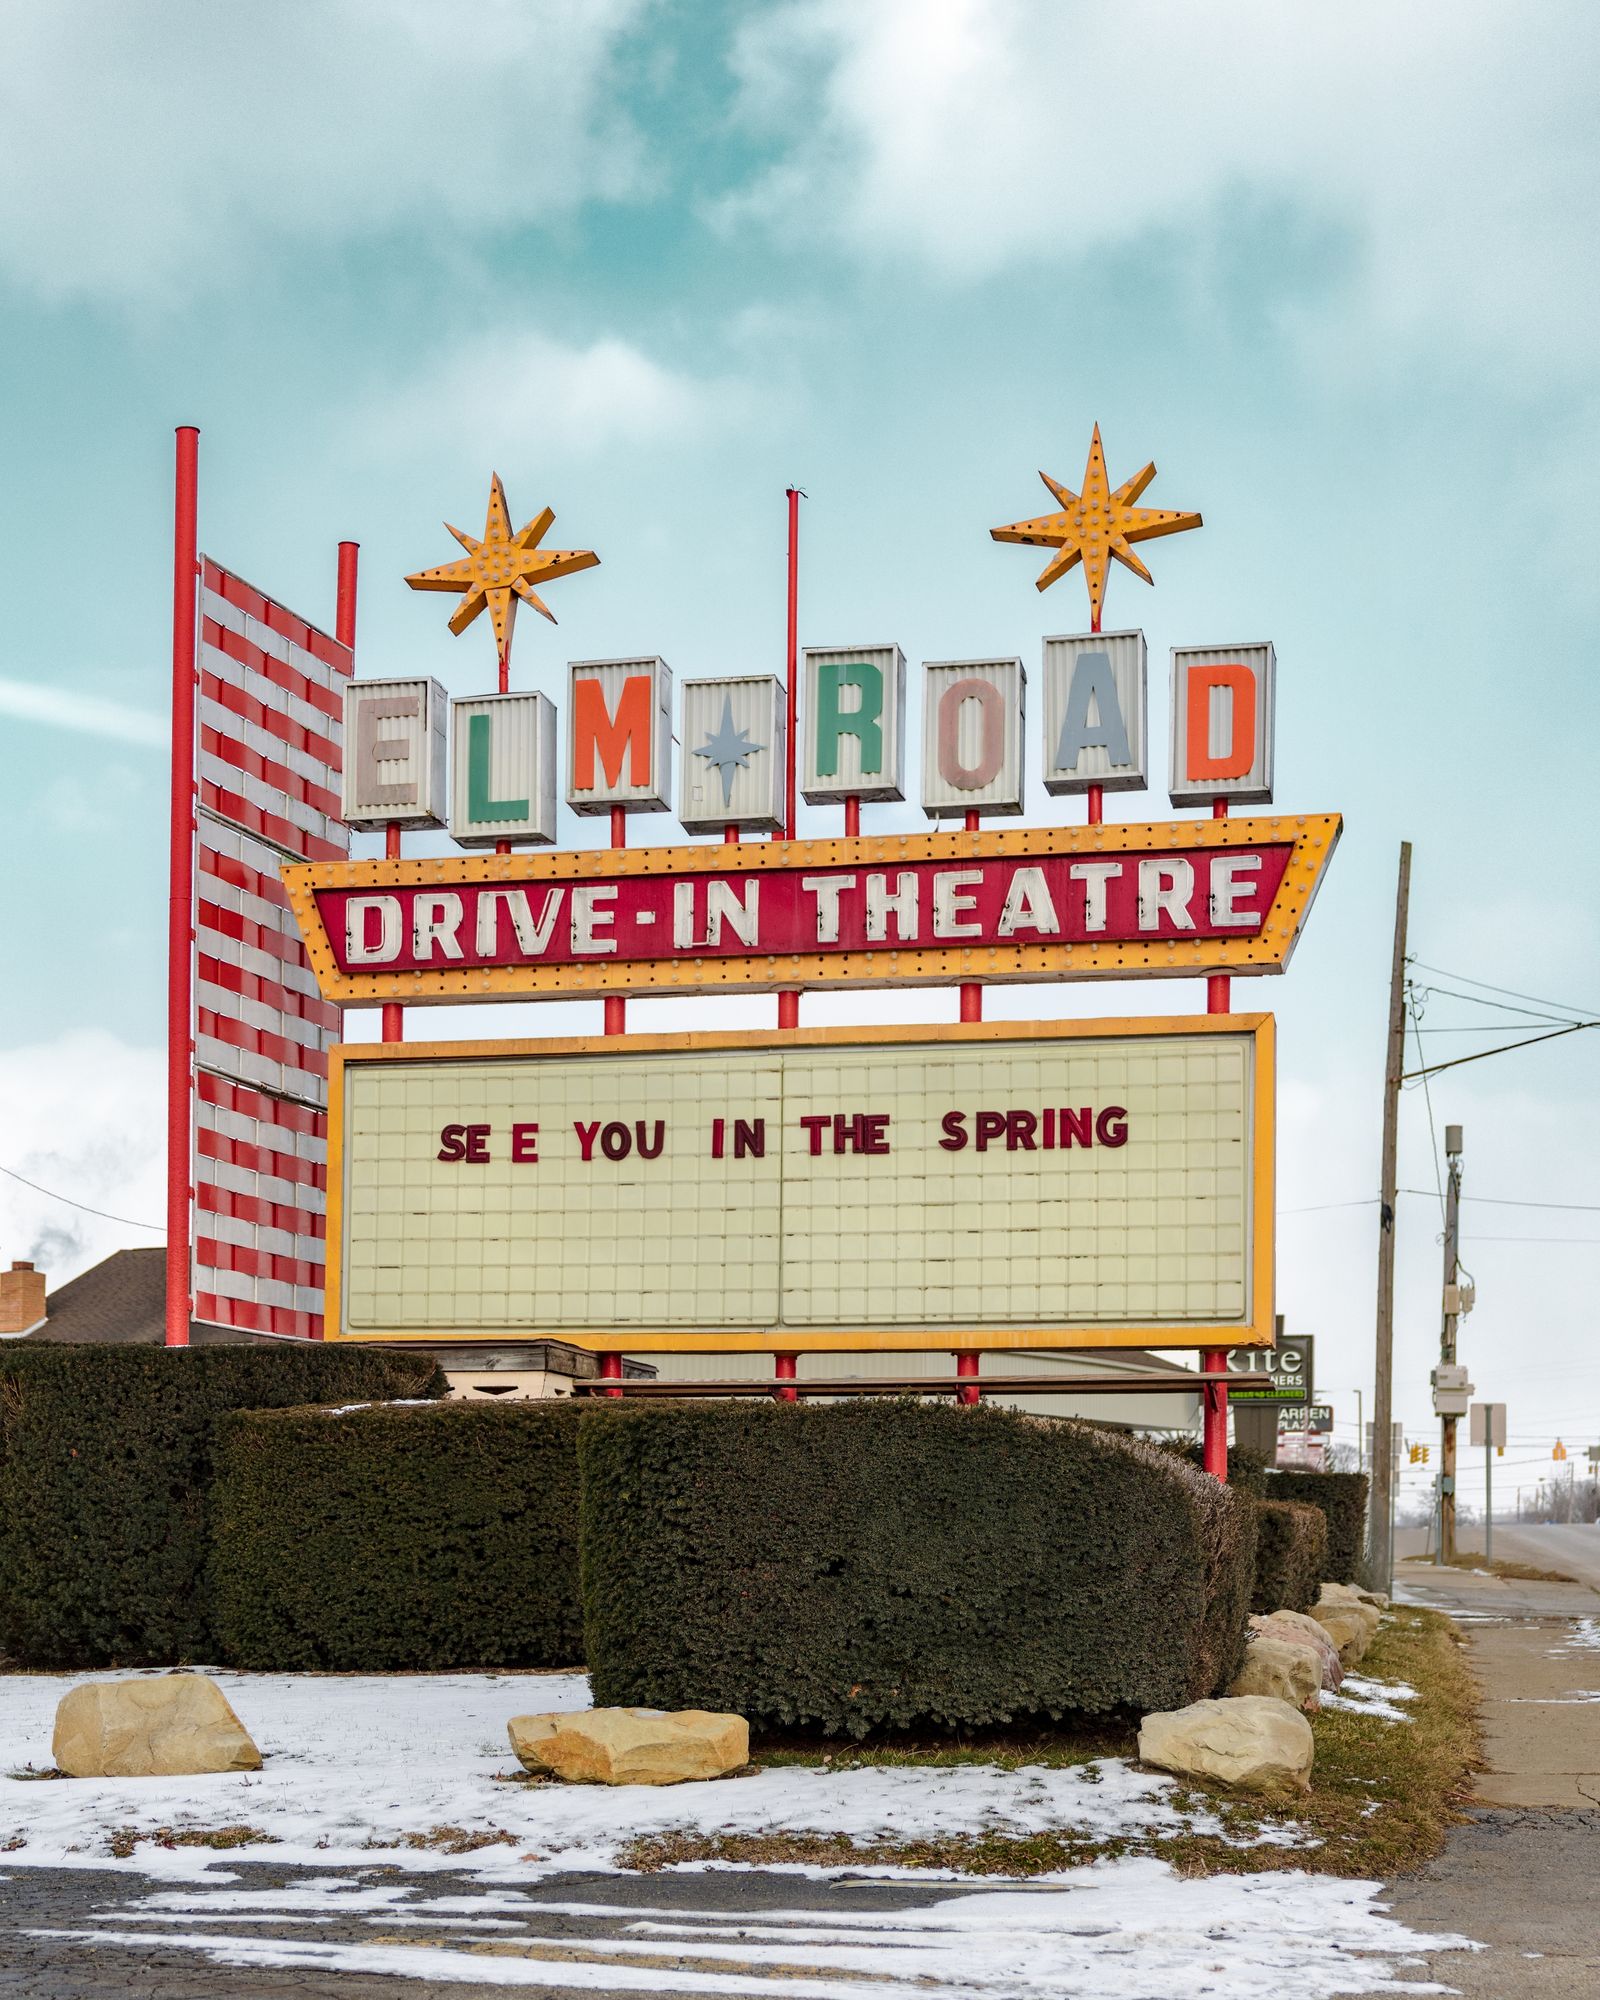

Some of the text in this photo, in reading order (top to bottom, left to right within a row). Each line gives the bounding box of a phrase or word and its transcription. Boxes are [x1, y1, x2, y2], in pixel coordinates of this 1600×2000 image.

[357, 652, 1257, 823] ELM ROAD
[802, 855, 1262, 943] THEATRE
[573, 1119, 665, 1162] YOU
[711, 1118, 766, 1159] IN
[800, 1113, 891, 1156] THE
[938, 1106, 1129, 1152] SPRING
